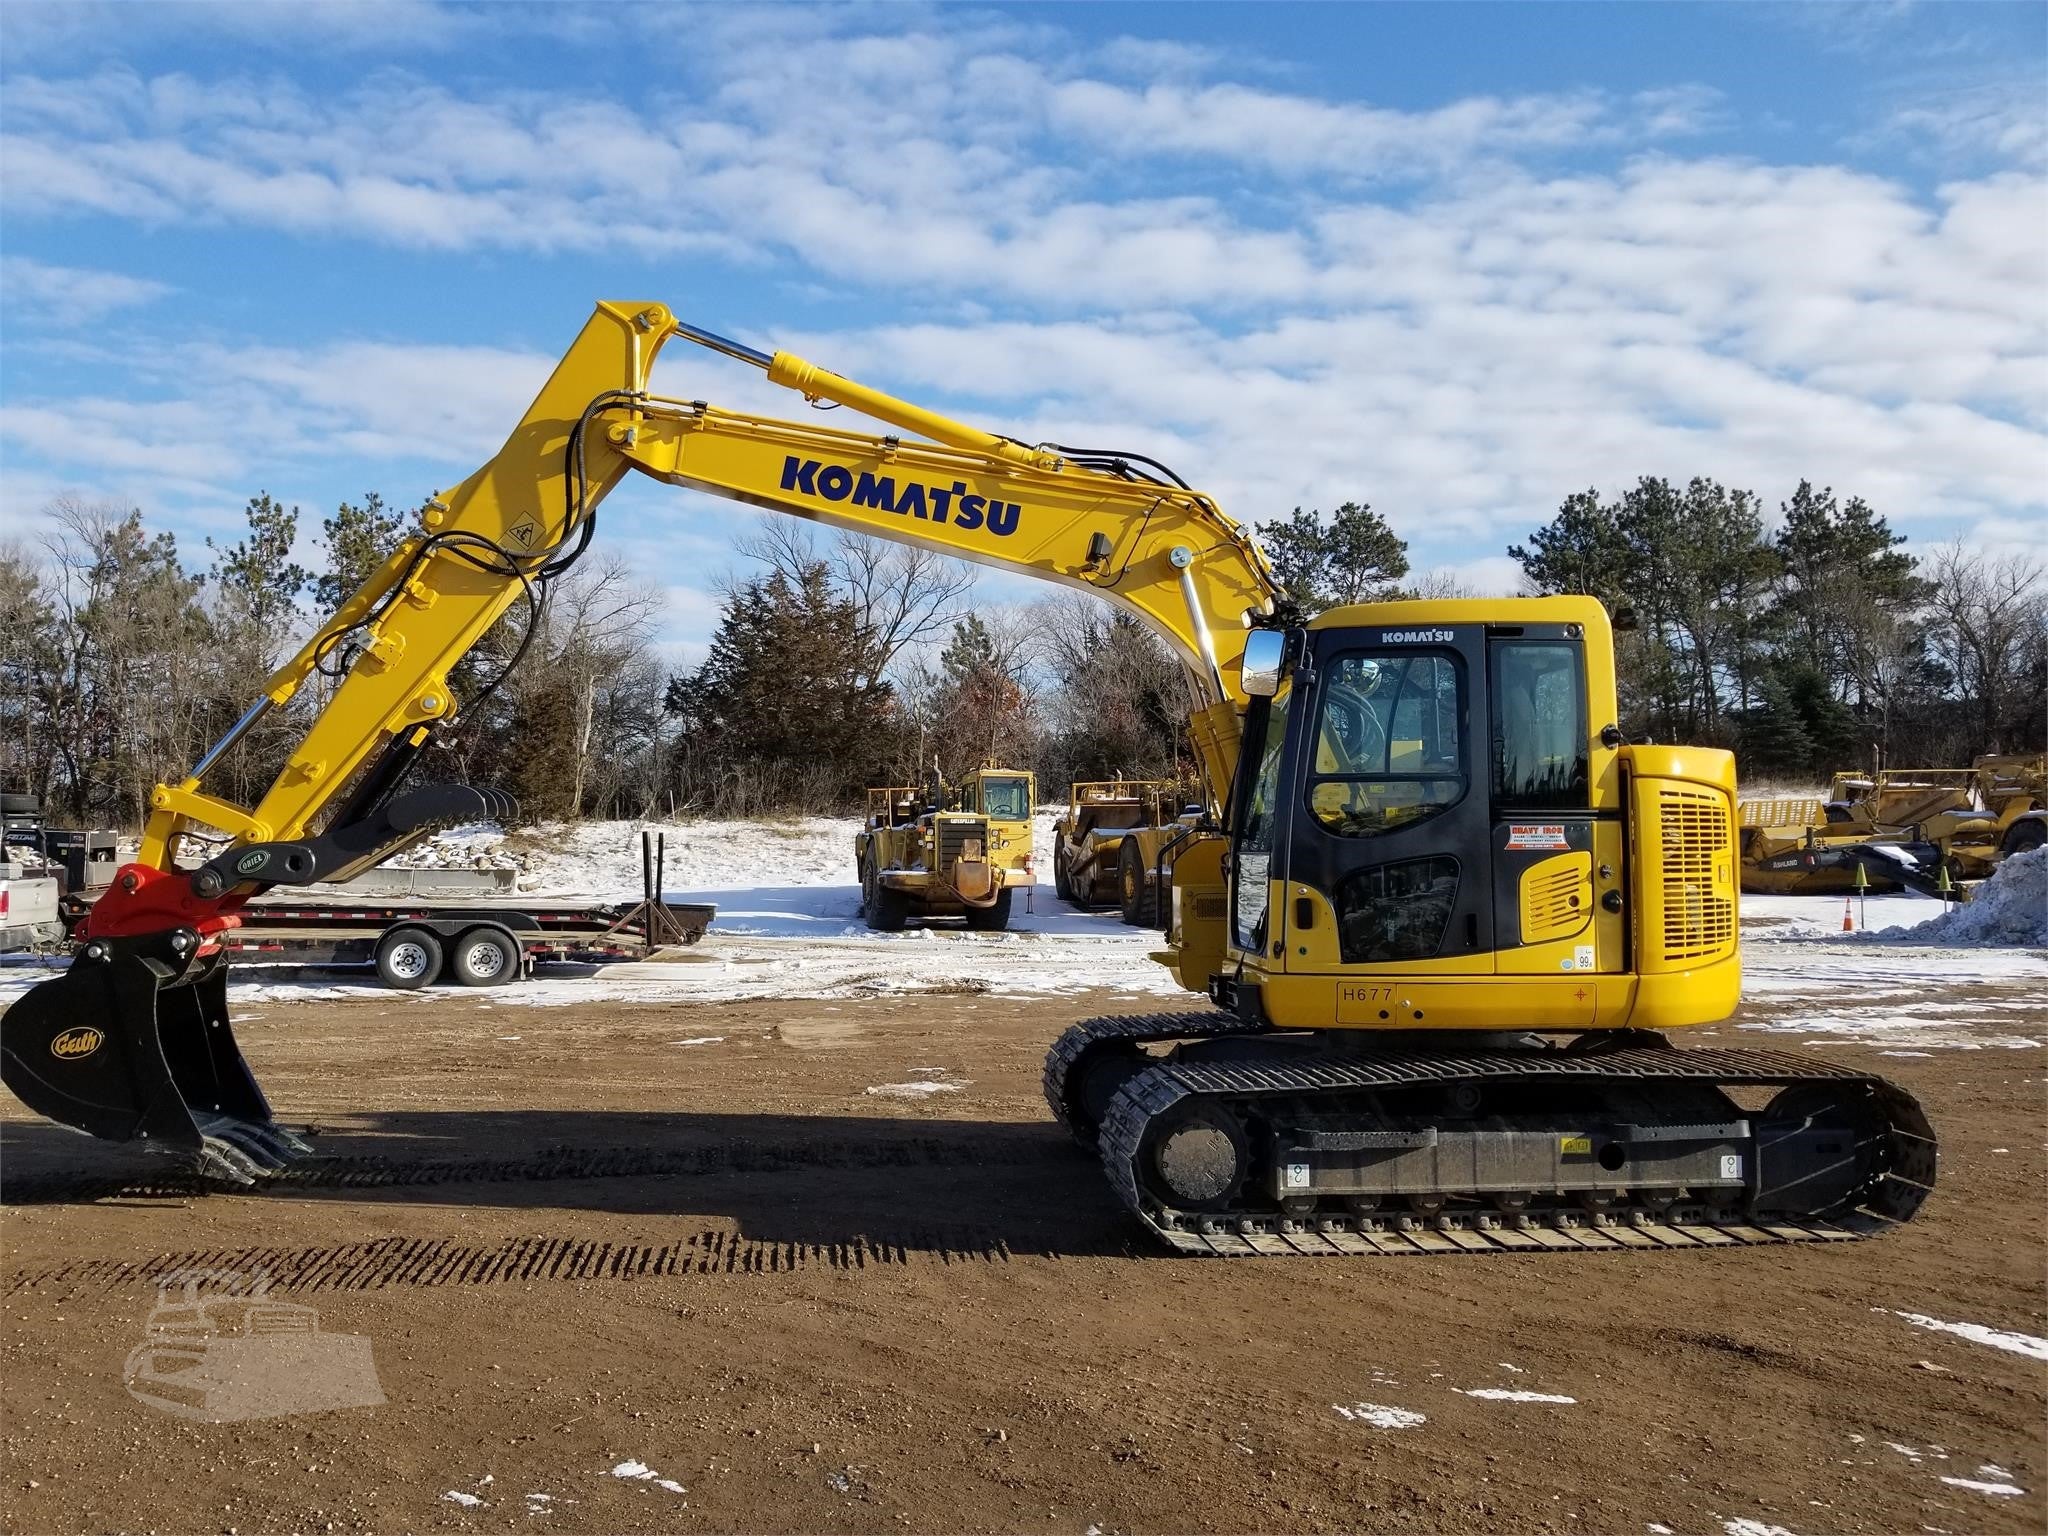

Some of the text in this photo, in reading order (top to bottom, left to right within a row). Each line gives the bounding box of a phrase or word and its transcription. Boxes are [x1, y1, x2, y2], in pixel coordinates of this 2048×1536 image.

[779, 455, 1022, 537] KOMATSU
[1382, 628, 1454, 643] KOMATSU
[242, 854, 263, 870] ORIEL
[1579, 956, 1589, 968] 99
[1343, 988, 1392, 1001] H677
